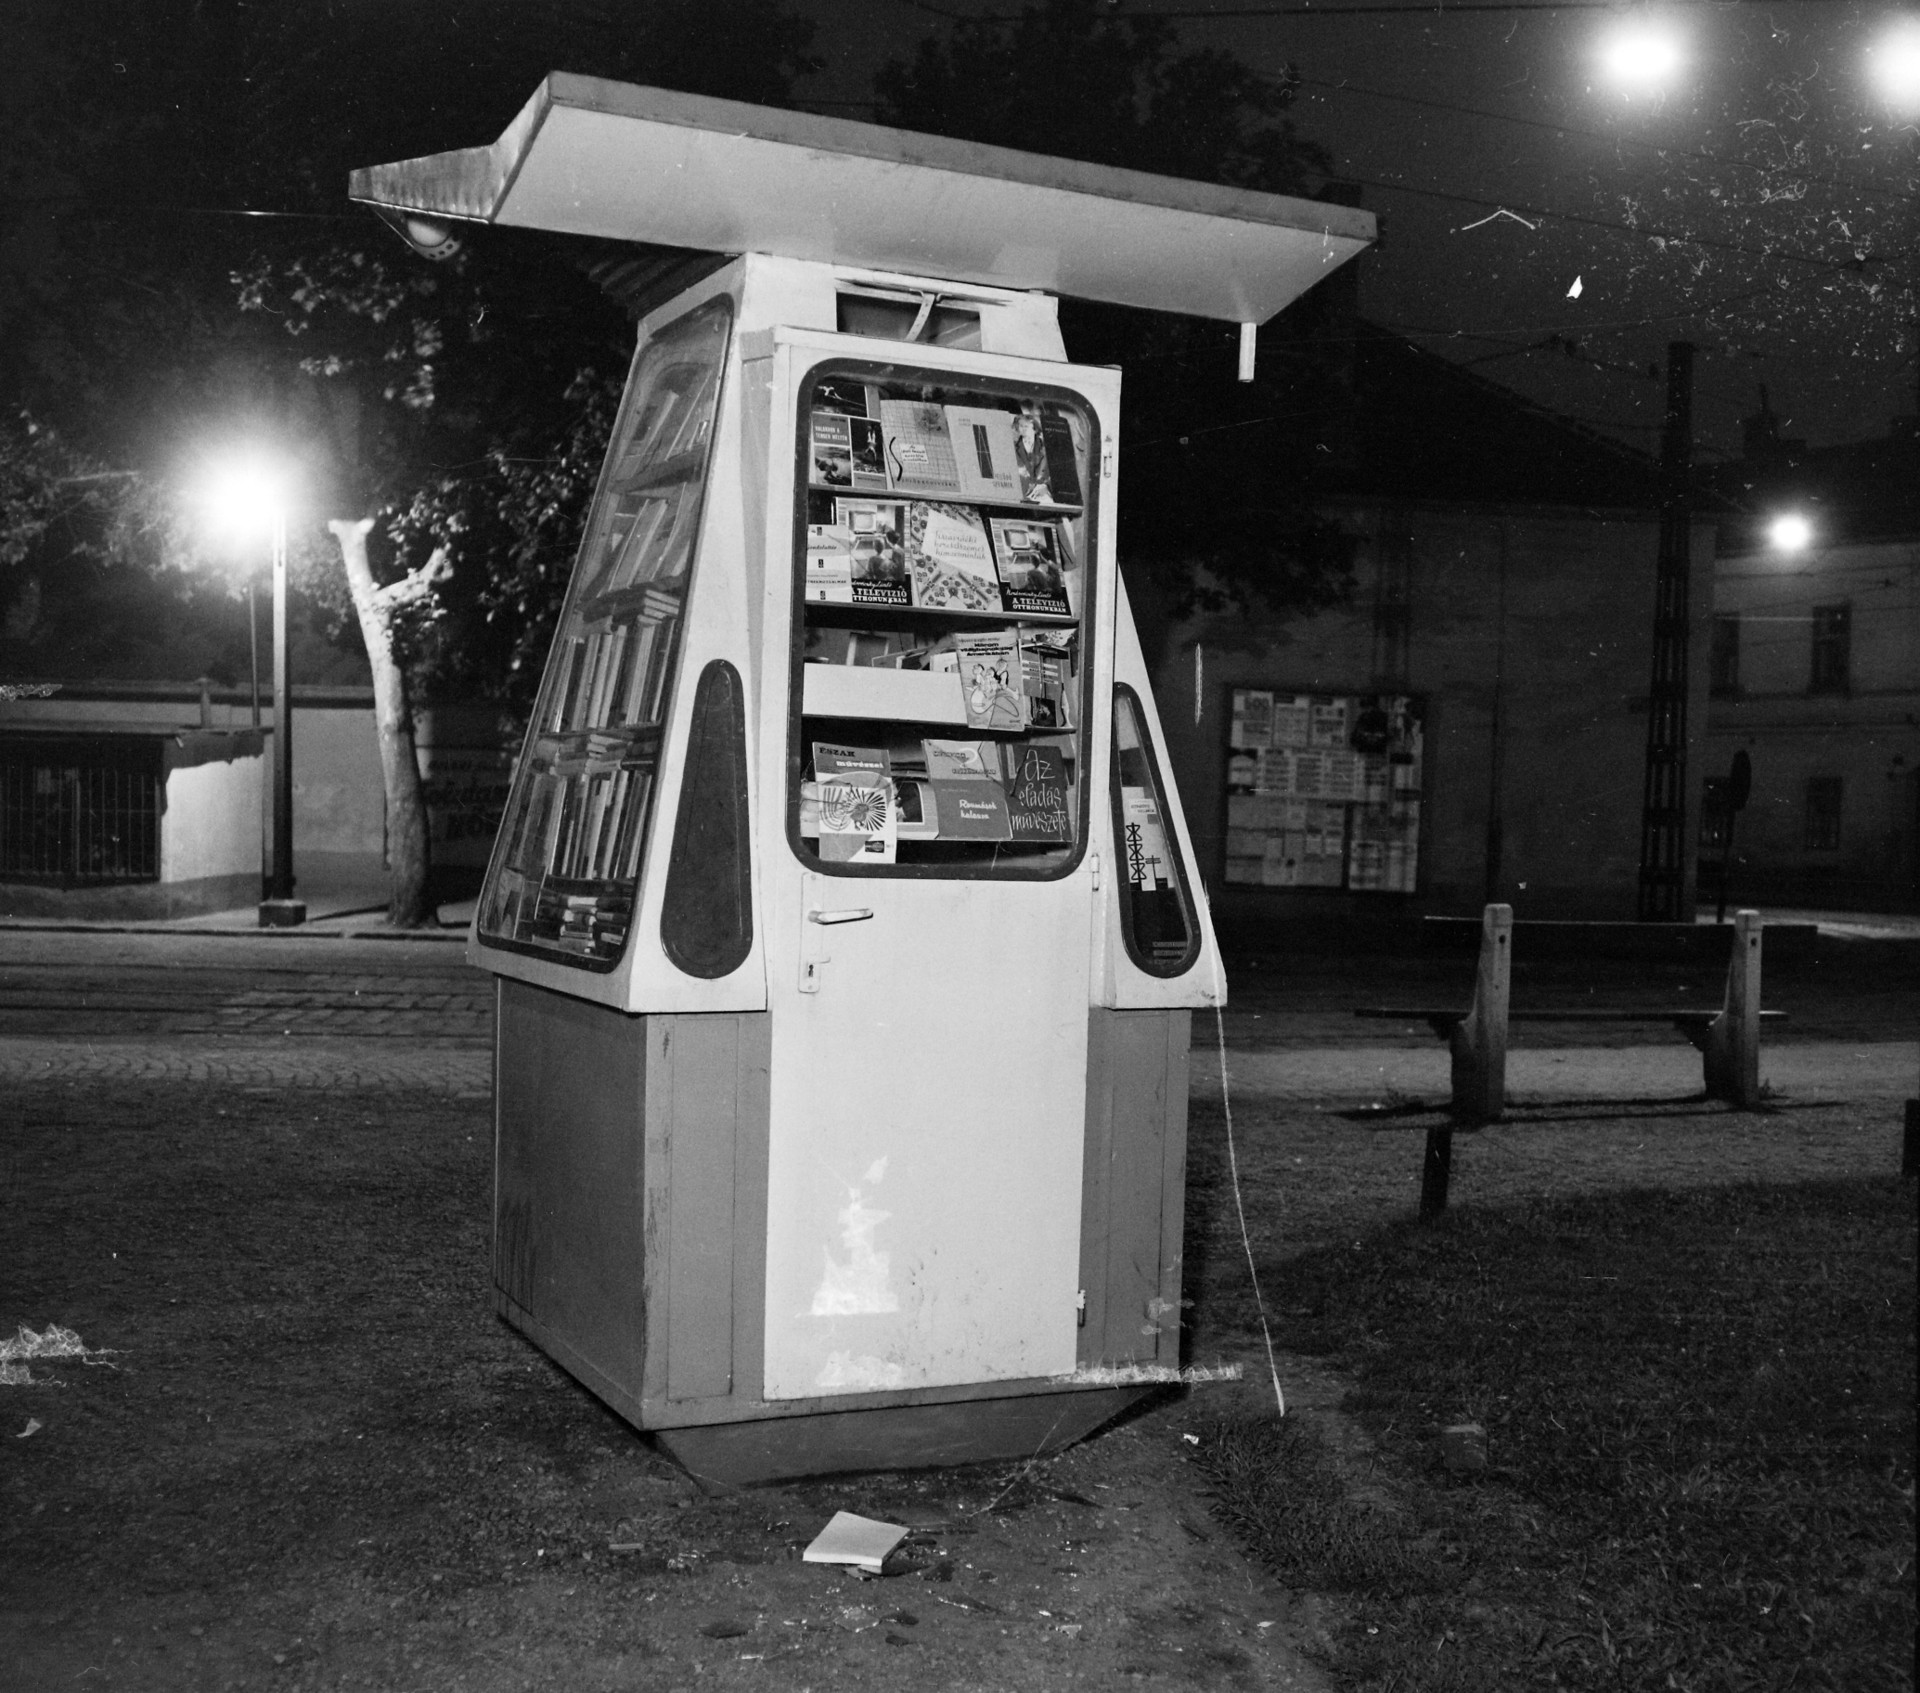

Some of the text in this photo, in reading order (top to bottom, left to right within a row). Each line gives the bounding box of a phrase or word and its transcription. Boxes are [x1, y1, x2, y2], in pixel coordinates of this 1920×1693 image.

[852, 595, 907, 604] TTHONUNKBAN
[1025, 749, 1056, 781] Az
[1018, 782, 1062, 809] eladás
[1011, 809, 1067, 835] művészete
